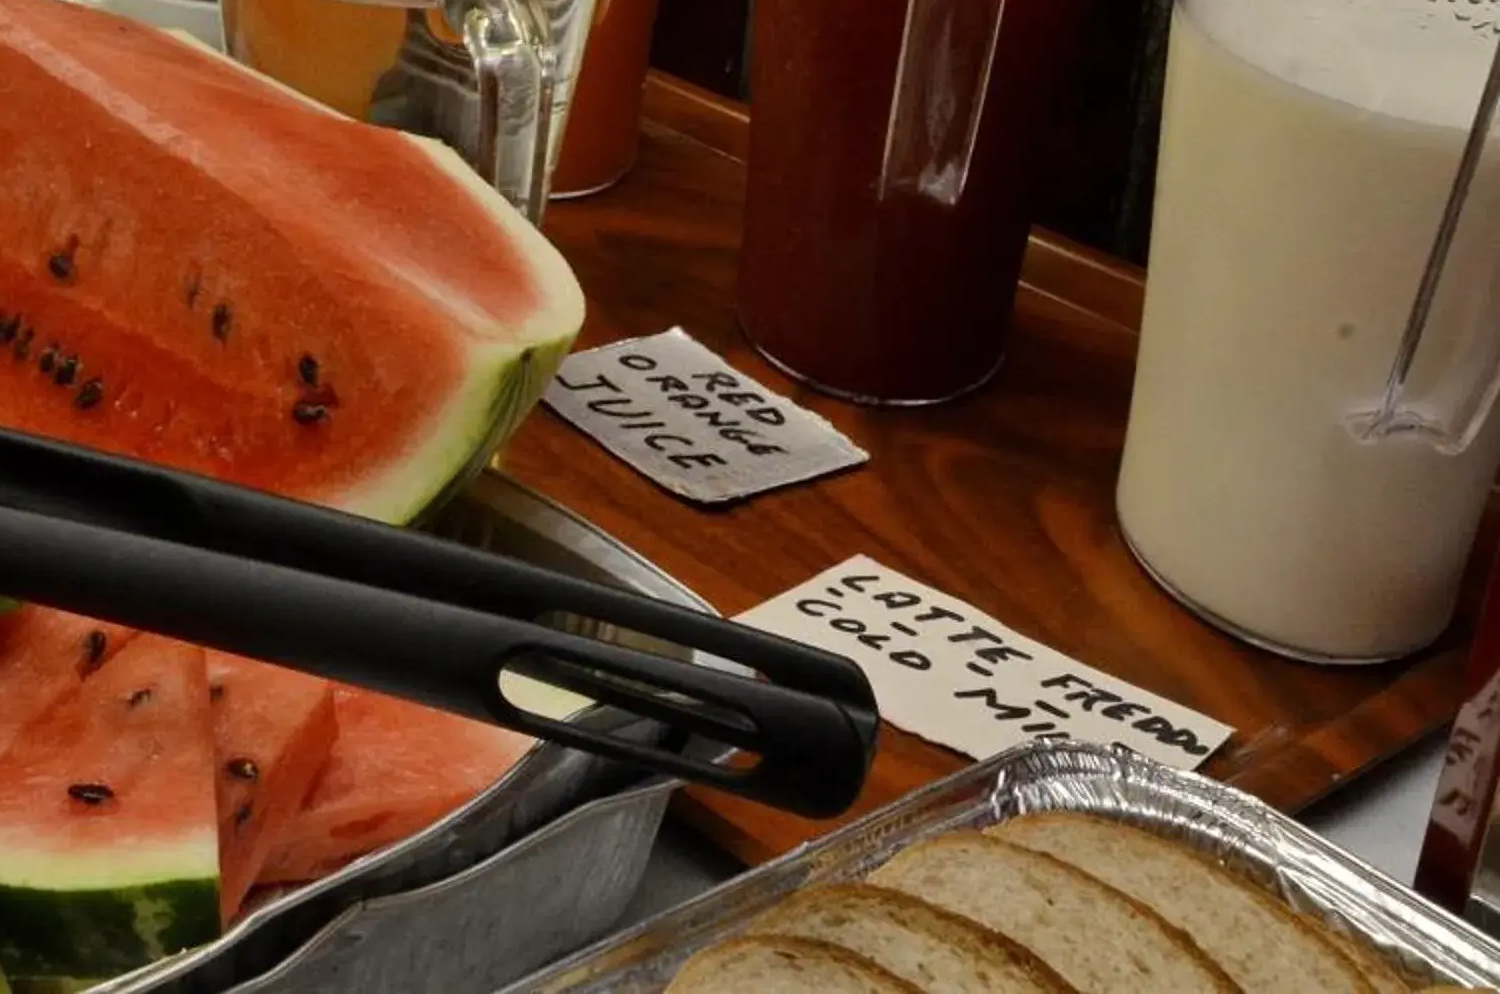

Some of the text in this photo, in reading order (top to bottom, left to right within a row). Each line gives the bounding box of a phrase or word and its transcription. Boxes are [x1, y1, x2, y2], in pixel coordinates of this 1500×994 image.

[554, 374, 728, 470] JUICE
[618, 354, 789, 456] ORANGE
[691, 371, 786, 426] RED
[795, 598, 932, 671] COLD
[841, 574, 1034, 664] LATTE
